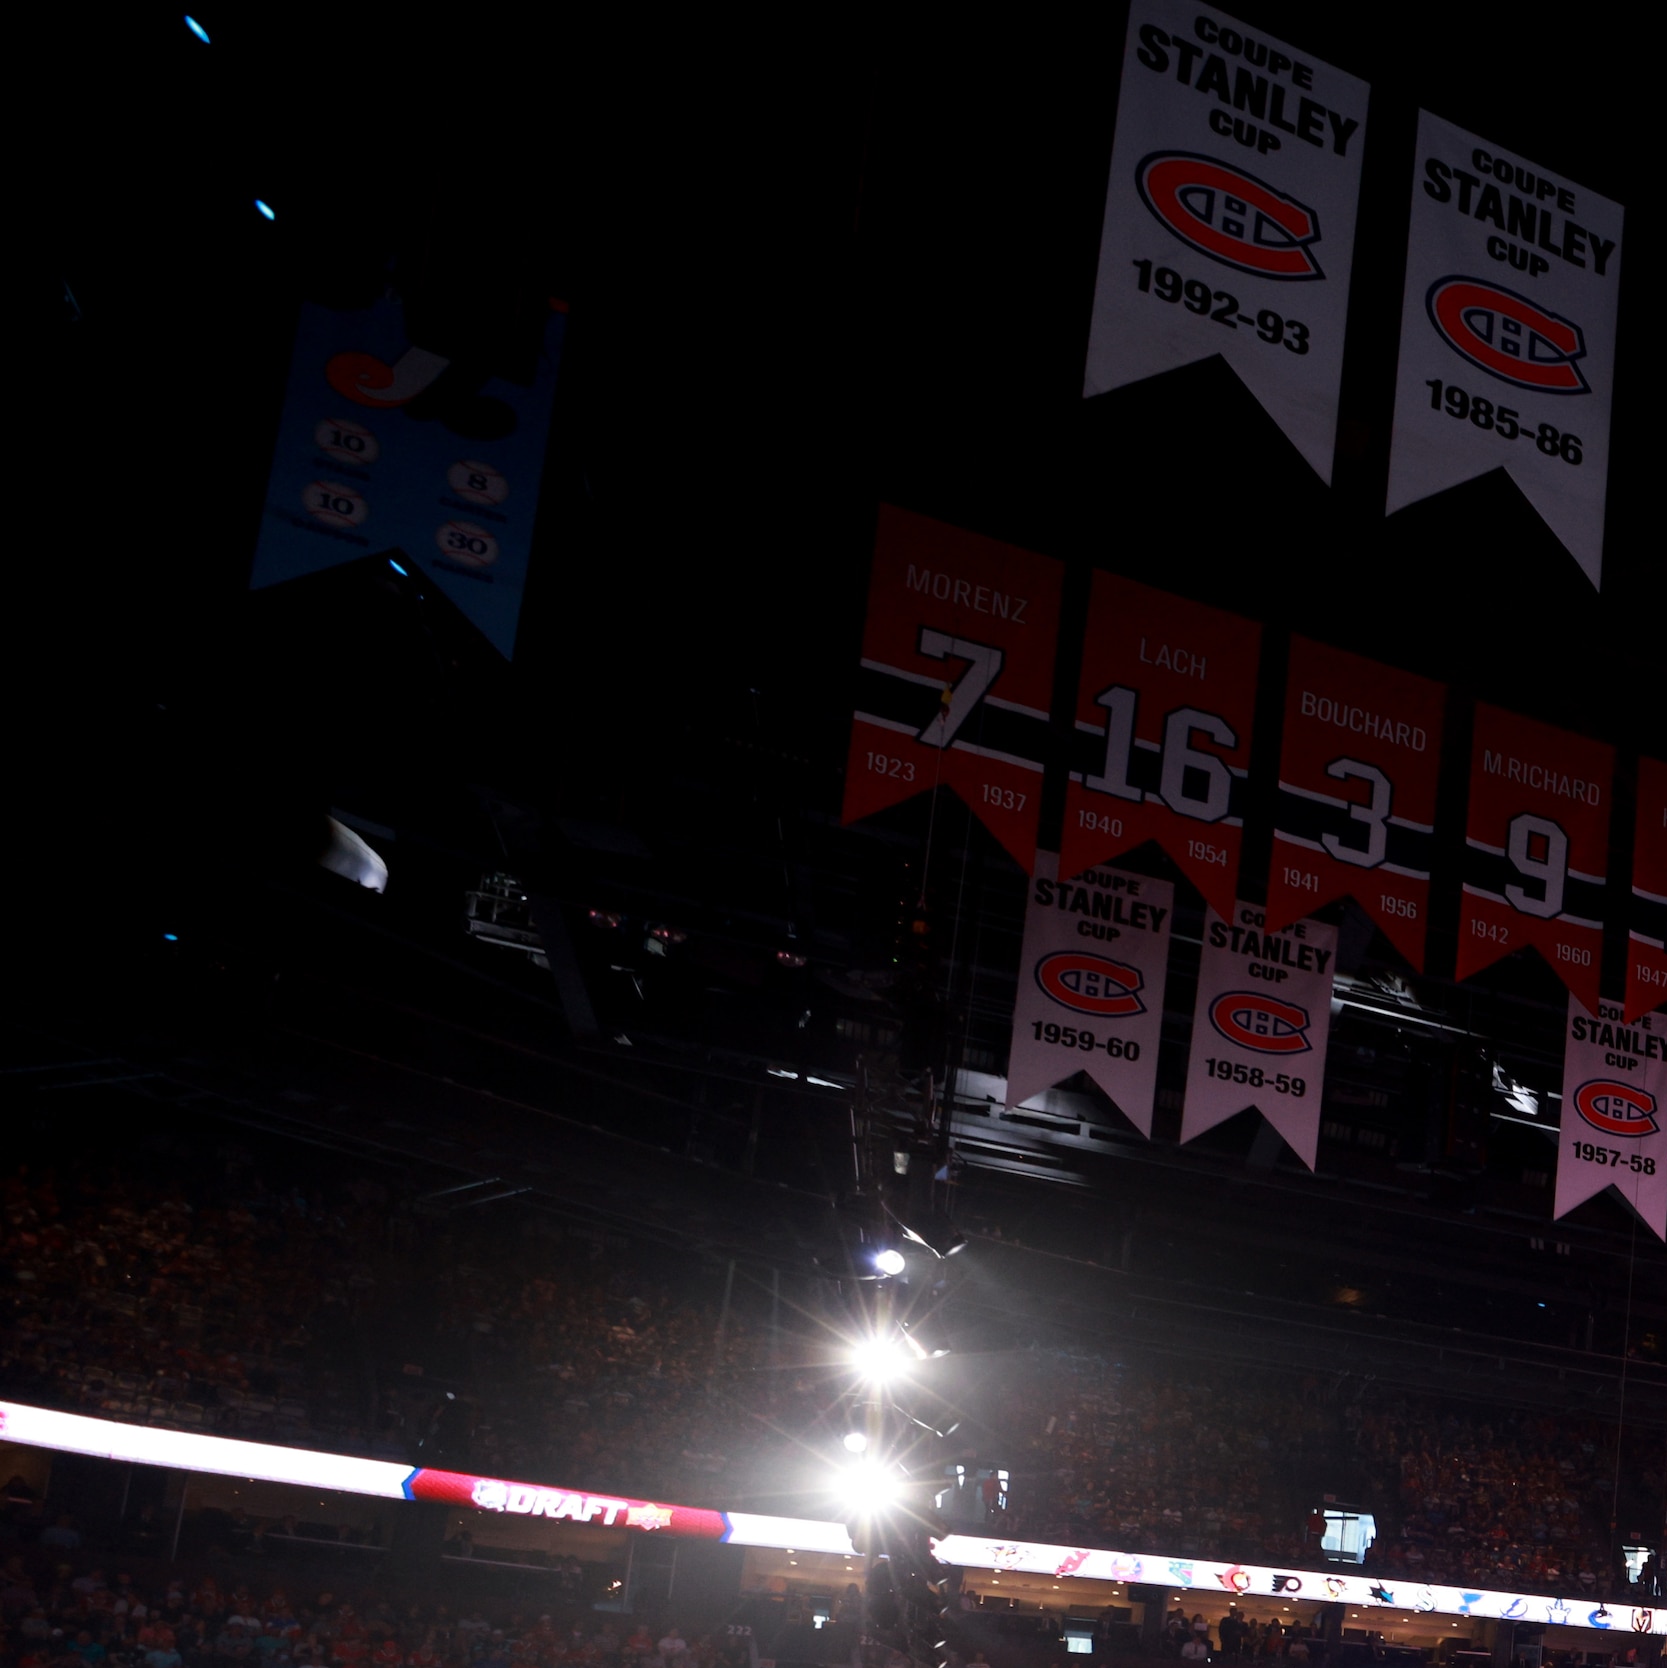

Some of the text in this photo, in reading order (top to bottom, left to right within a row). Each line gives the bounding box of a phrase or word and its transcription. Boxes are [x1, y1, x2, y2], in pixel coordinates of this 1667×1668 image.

[1194, 15, 1313, 91] COUPE
[1136, 23, 1359, 158] STANLEY
[1209, 107, 1282, 156] CUP
[1471, 147, 1576, 215] COUPE
[1423, 157, 1617, 277] STANLEY
[1486, 235, 1550, 279] CUP
[1132, 258, 1311, 356] 1992-93
[1424, 379, 1584, 467] 1985-86
[905, 562, 1029, 625] MORENZ
[1138, 636, 1208, 681] LACH
[916, 625, 1004, 750] 7
[1300, 691, 1427, 753] BOUCHARD
[865, 751, 917, 783] 1923
[1085, 684, 1241, 825] 16
[981, 782, 1028, 813] 1937
[1482, 749, 1601, 808] M.RICHARD
[1077, 809, 1124, 839] 1940
[1318, 756, 1394, 870] 3
[1186, 839, 1228, 868] 1954
[1504, 812, 1569, 920] 9
[1282, 866, 1320, 894] 1941
[1034, 877, 1167, 934] STANLEY
[1379, 893, 1418, 921] 1956
[1077, 919, 1121, 944] CUP
[1209, 921, 1332, 976] STANLEY
[1470, 918, 1510, 946] 1942
[1248, 959, 1288, 984] CUP
[1555, 942, 1592, 968] 1960
[1032, 1020, 1141, 1062] 1959-60
[1605, 1051, 1639, 1072] CUP
[1205, 1056, 1307, 1099] 1958-59
[1572, 1140, 1656, 1176] 1957-58
[508, 1487, 628, 1527] DRAFT
